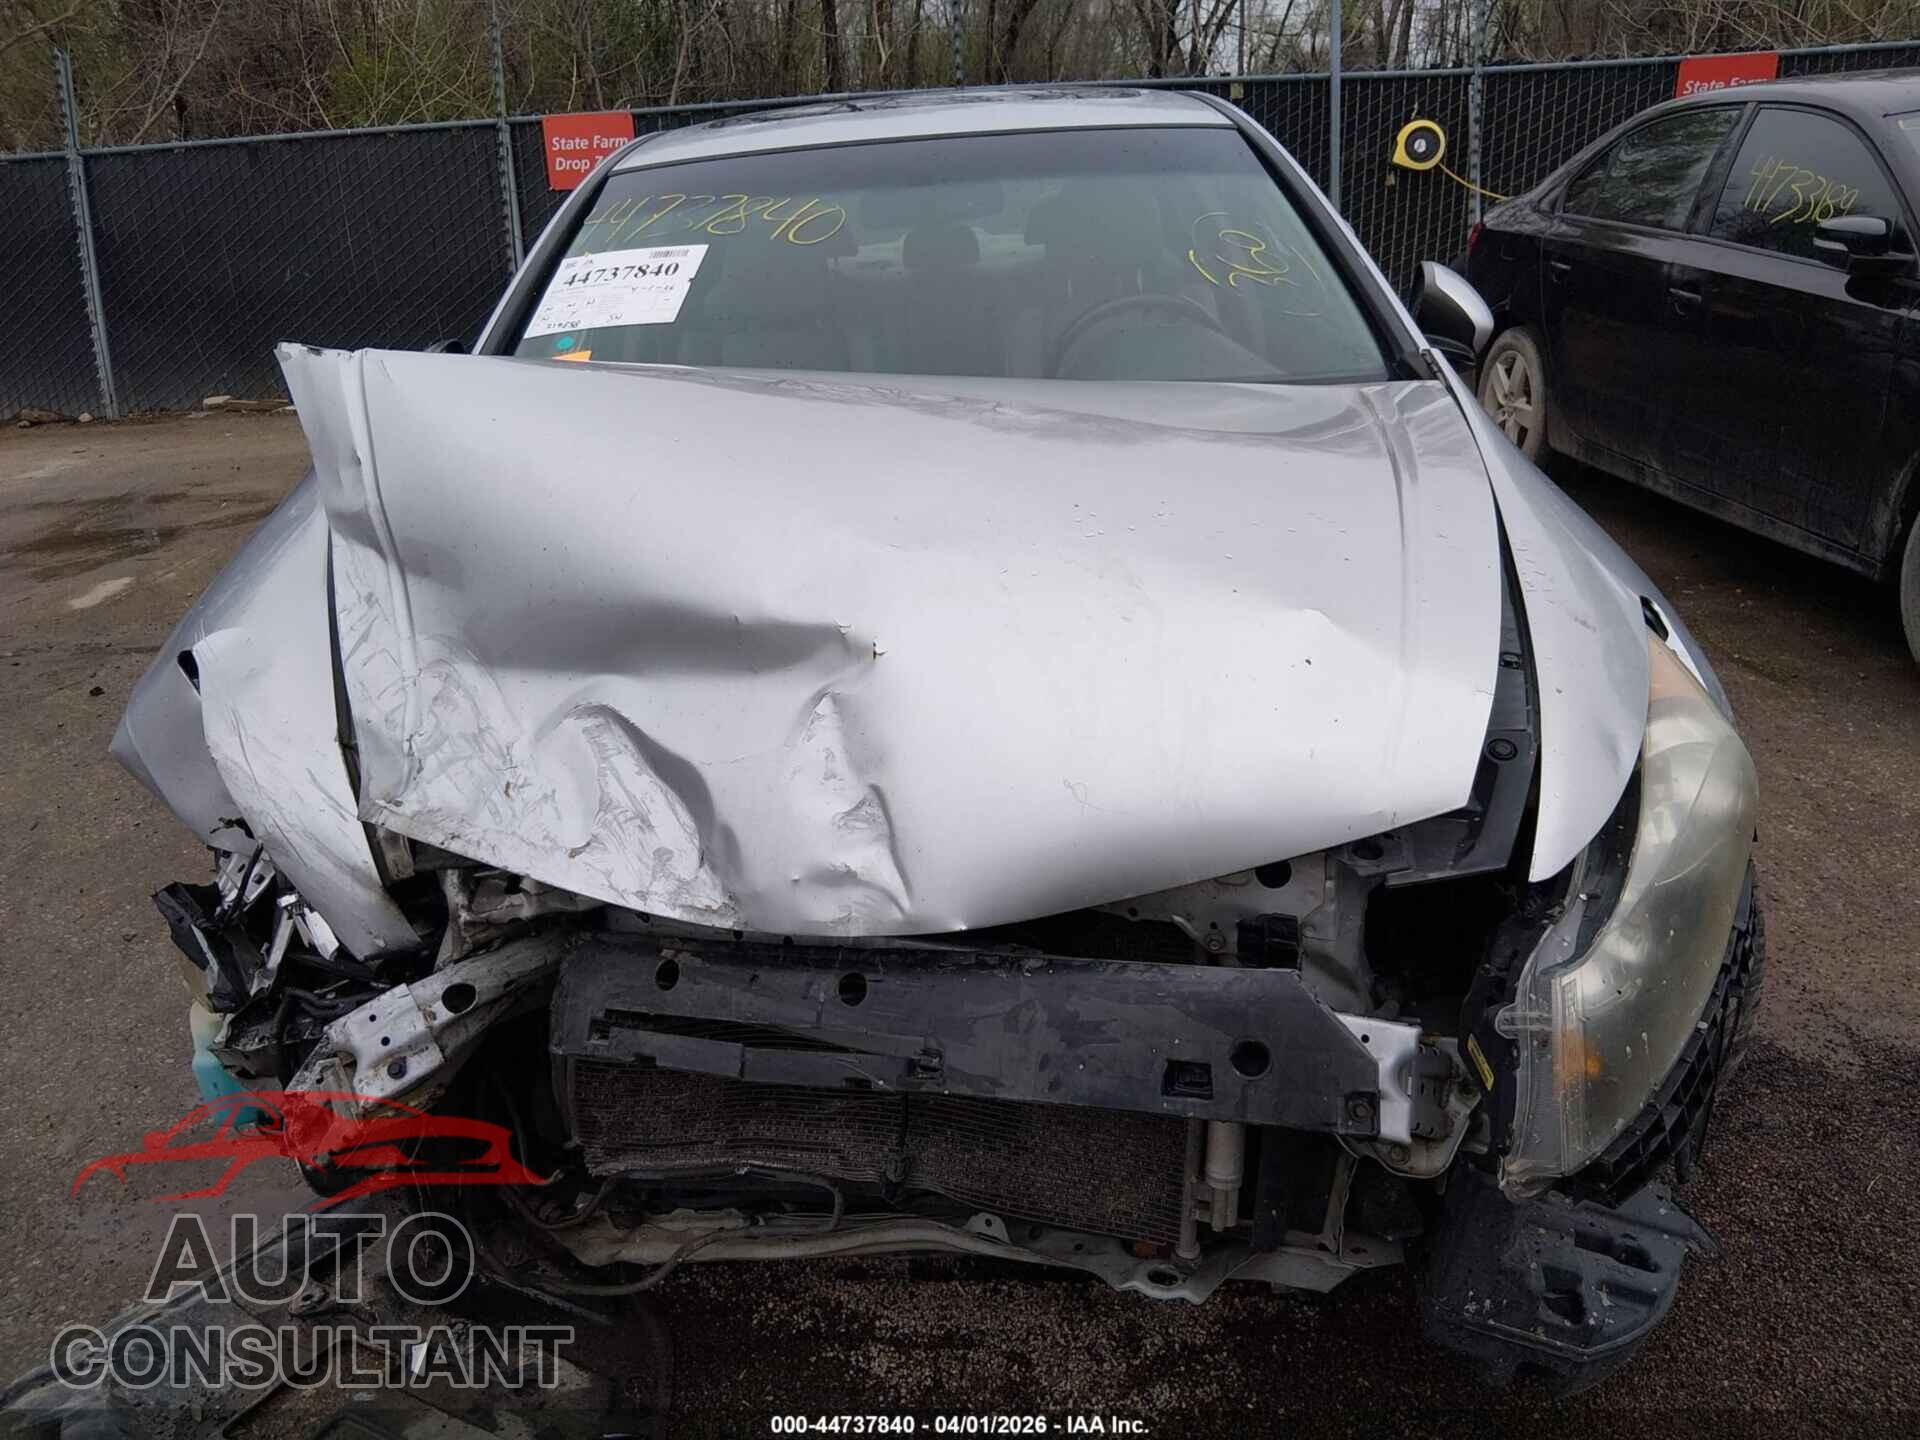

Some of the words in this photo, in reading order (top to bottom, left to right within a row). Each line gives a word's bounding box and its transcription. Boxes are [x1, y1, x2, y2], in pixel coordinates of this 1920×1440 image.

[551, 136, 589, 151] State
[593, 135, 629, 149] Farm
[555, 156, 590, 173] Drop
[563, 262, 680, 287] 44737840
